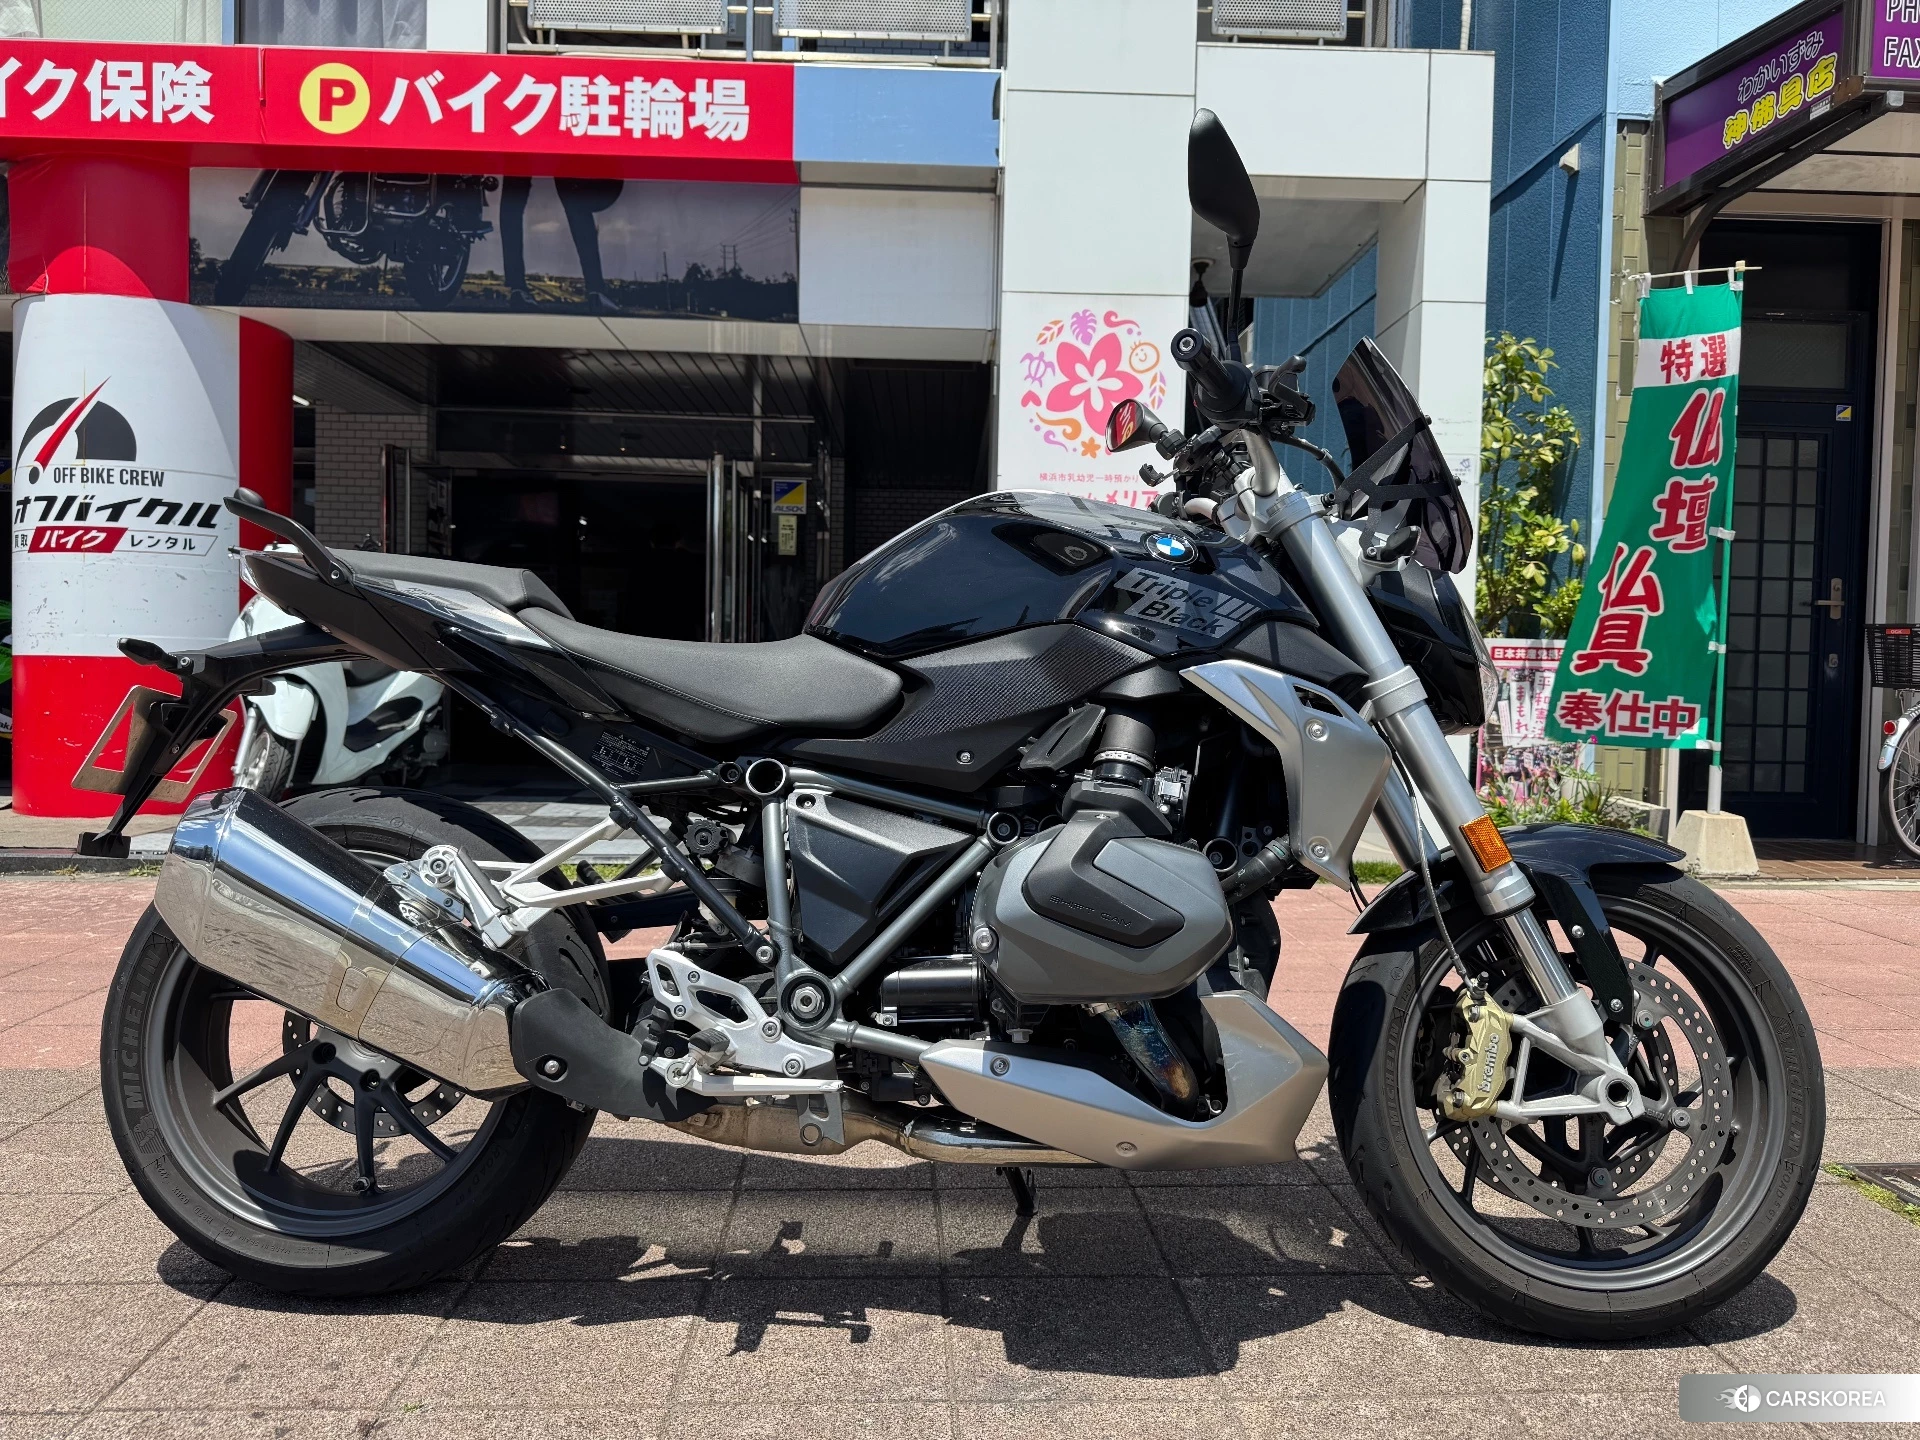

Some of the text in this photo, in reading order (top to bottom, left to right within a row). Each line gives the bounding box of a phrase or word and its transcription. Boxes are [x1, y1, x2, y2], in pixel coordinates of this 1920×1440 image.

[1886, 0, 1920, 23] PH
[379, 69, 750, 142] バイク駐輪場
[1660, 334, 1727, 384] 特選
[53, 467, 165, 487] OFF BIKE CREW
[1649, 388, 1726, 553] 仏壇
[39, 529, 107, 549] バイク
[131, 534, 195, 551] レンタル
[1131, 571, 1214, 608] Triple
[1570, 542, 1665, 677] 仏具
[1139, 601, 1224, 635] Black
[1559, 691, 1697, 736] 奉仕中
[122, 951, 163, 1110] MICHELIN
[1477, 1033, 1499, 1093] brembo
[1784, 1046, 1805, 1159] MICHELIN
